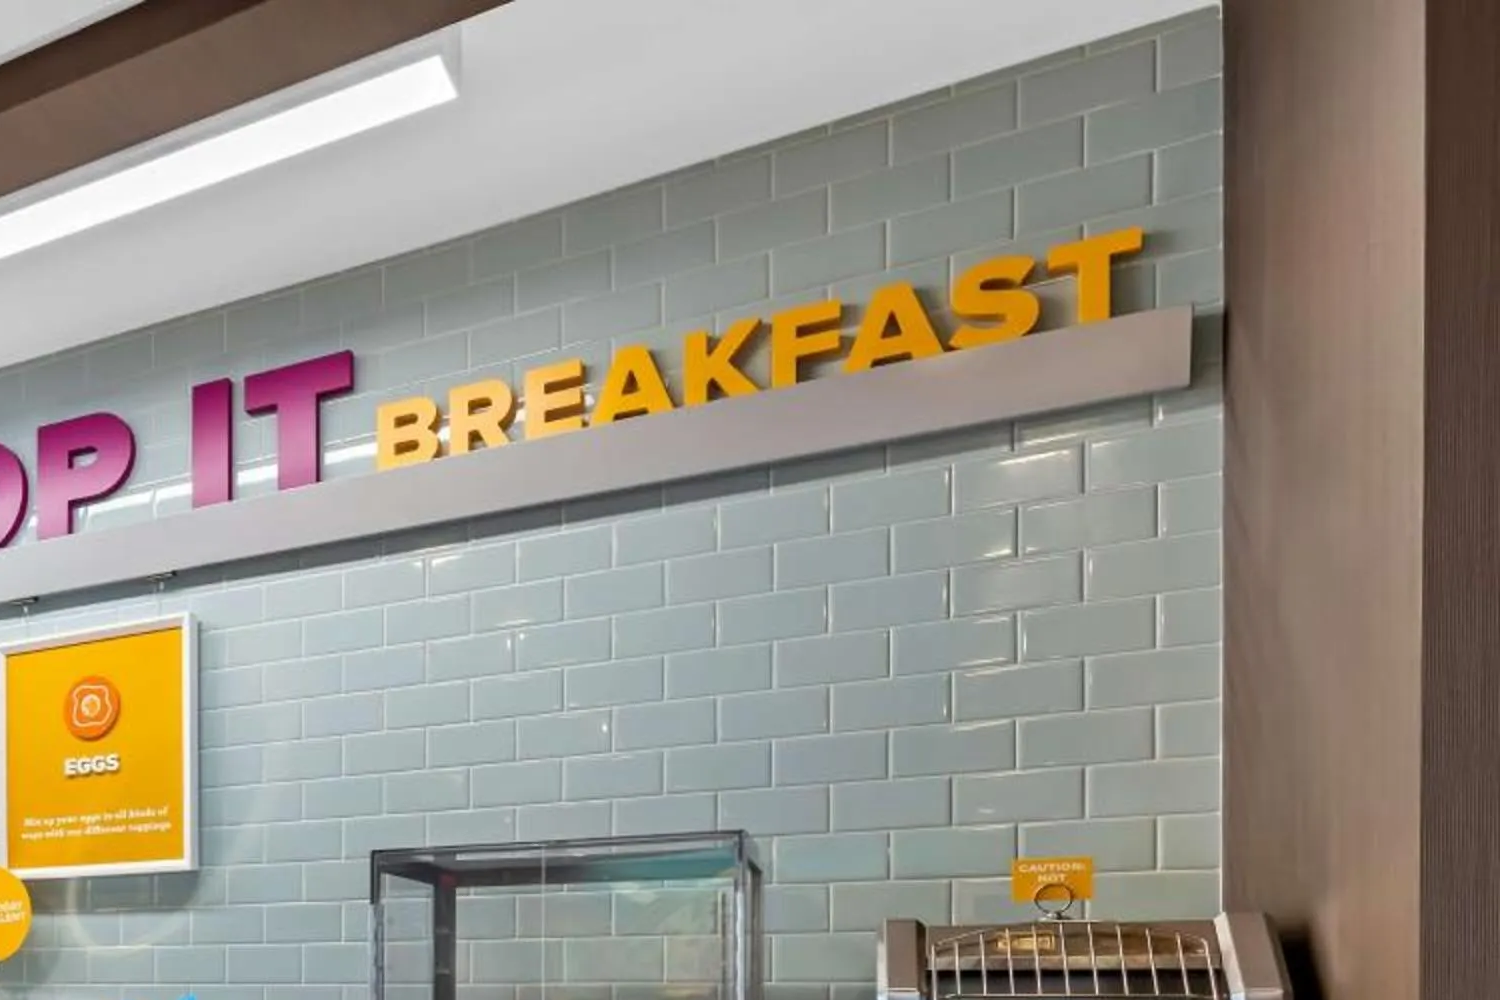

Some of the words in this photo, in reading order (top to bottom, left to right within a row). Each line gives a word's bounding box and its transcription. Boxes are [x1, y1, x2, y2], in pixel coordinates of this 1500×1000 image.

[191, 349, 355, 509] IT
[375, 227, 1143, 470] BREAKFAST
[63, 753, 120, 776] EGGS
